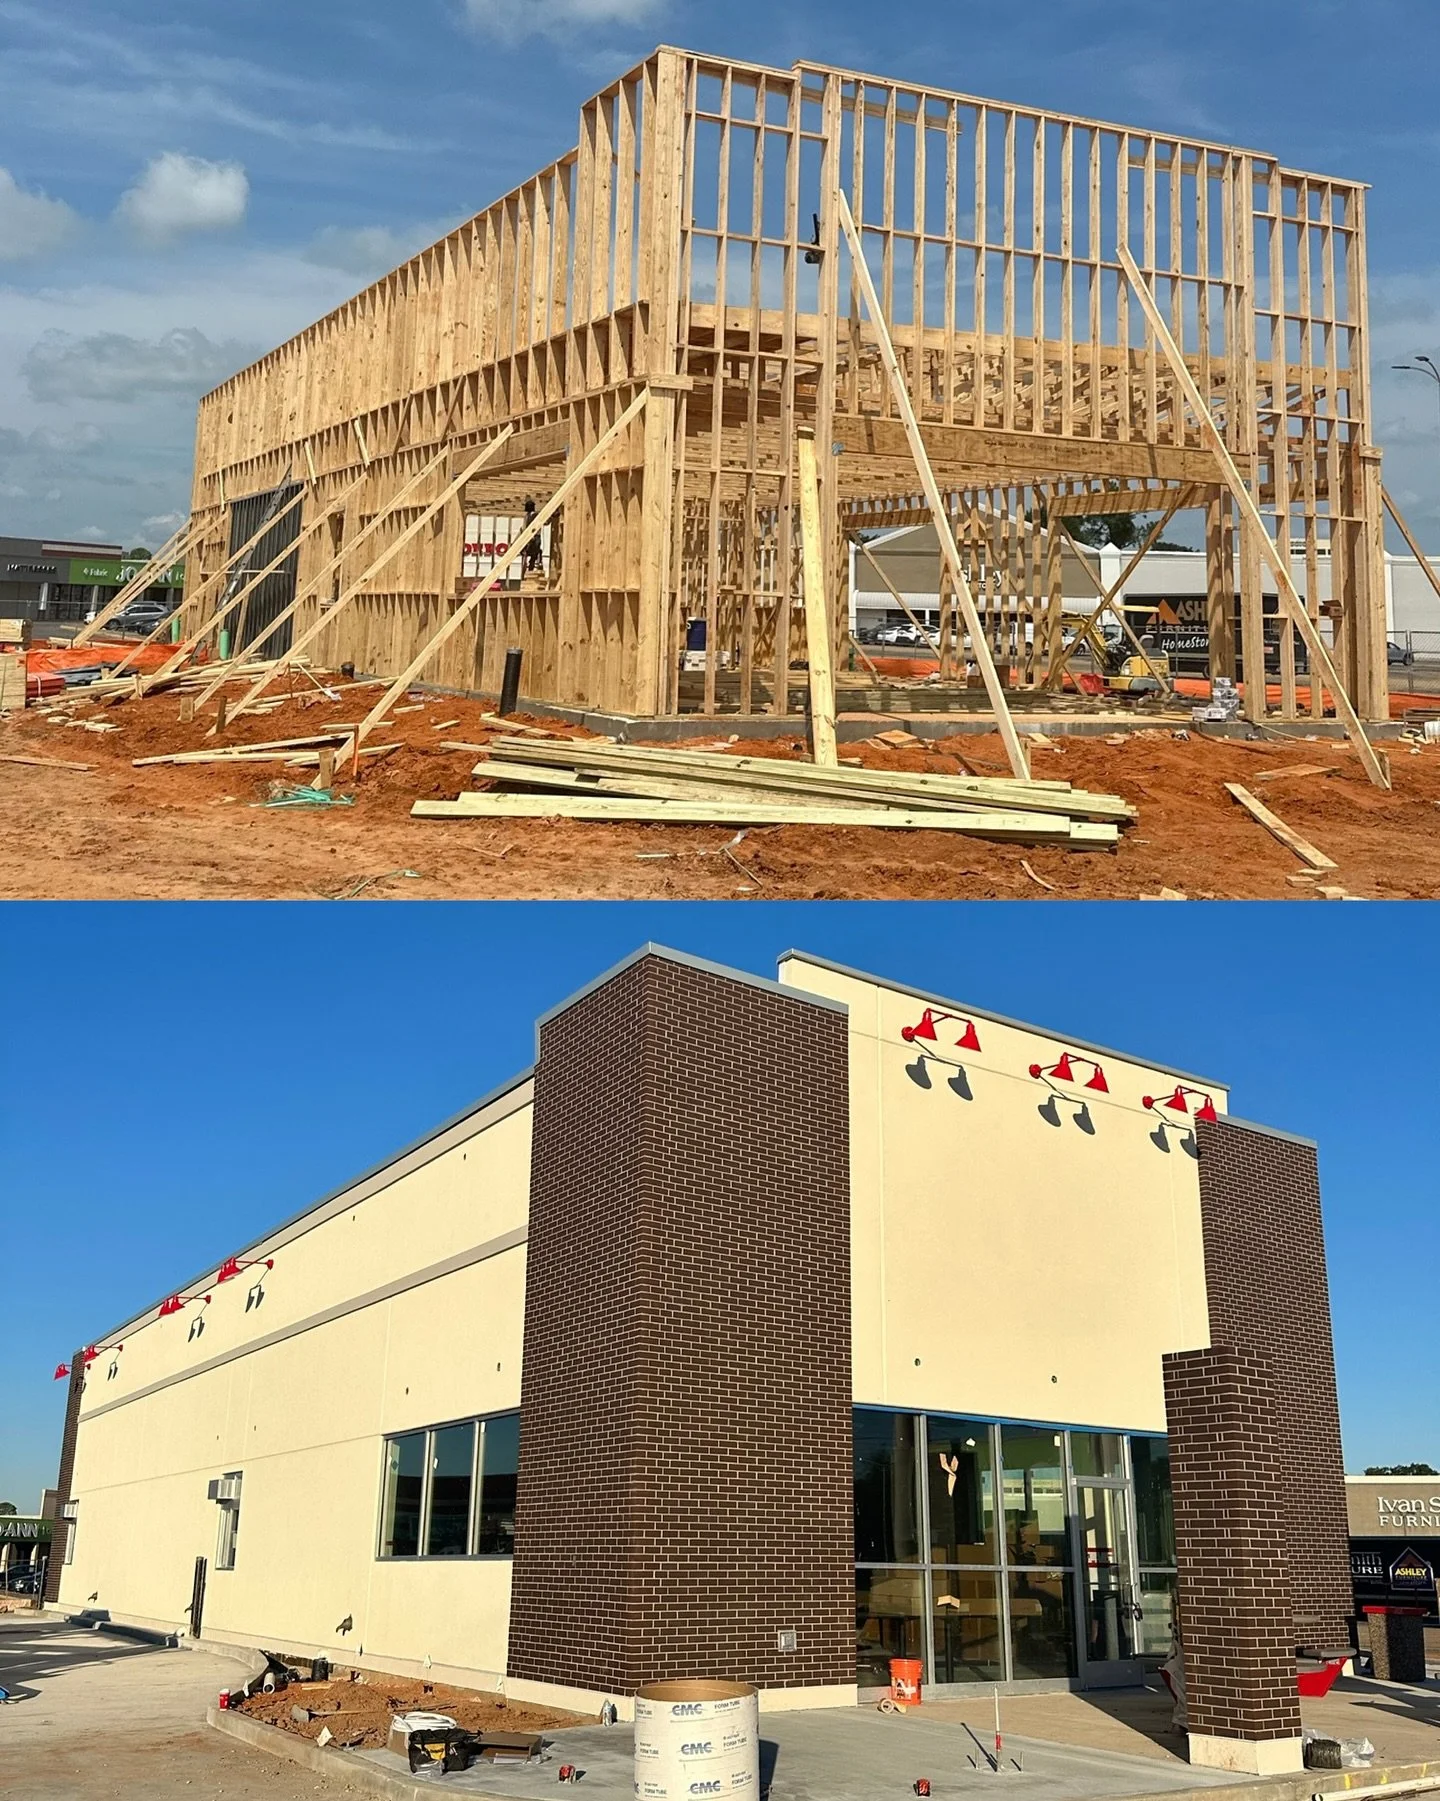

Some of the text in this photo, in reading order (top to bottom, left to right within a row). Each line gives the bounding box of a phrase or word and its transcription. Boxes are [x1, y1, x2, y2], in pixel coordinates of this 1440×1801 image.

[115, 565, 174, 584] JON
[1377, 1496, 1426, 1513] Ivan
[1380, 1516, 1440, 1527] FURNI
[671, 1703, 703, 1716] CMC
[714, 1702, 729, 1710] FORM
[681, 1742, 713, 1756] CMC
[690, 1780, 722, 1795] CMC
